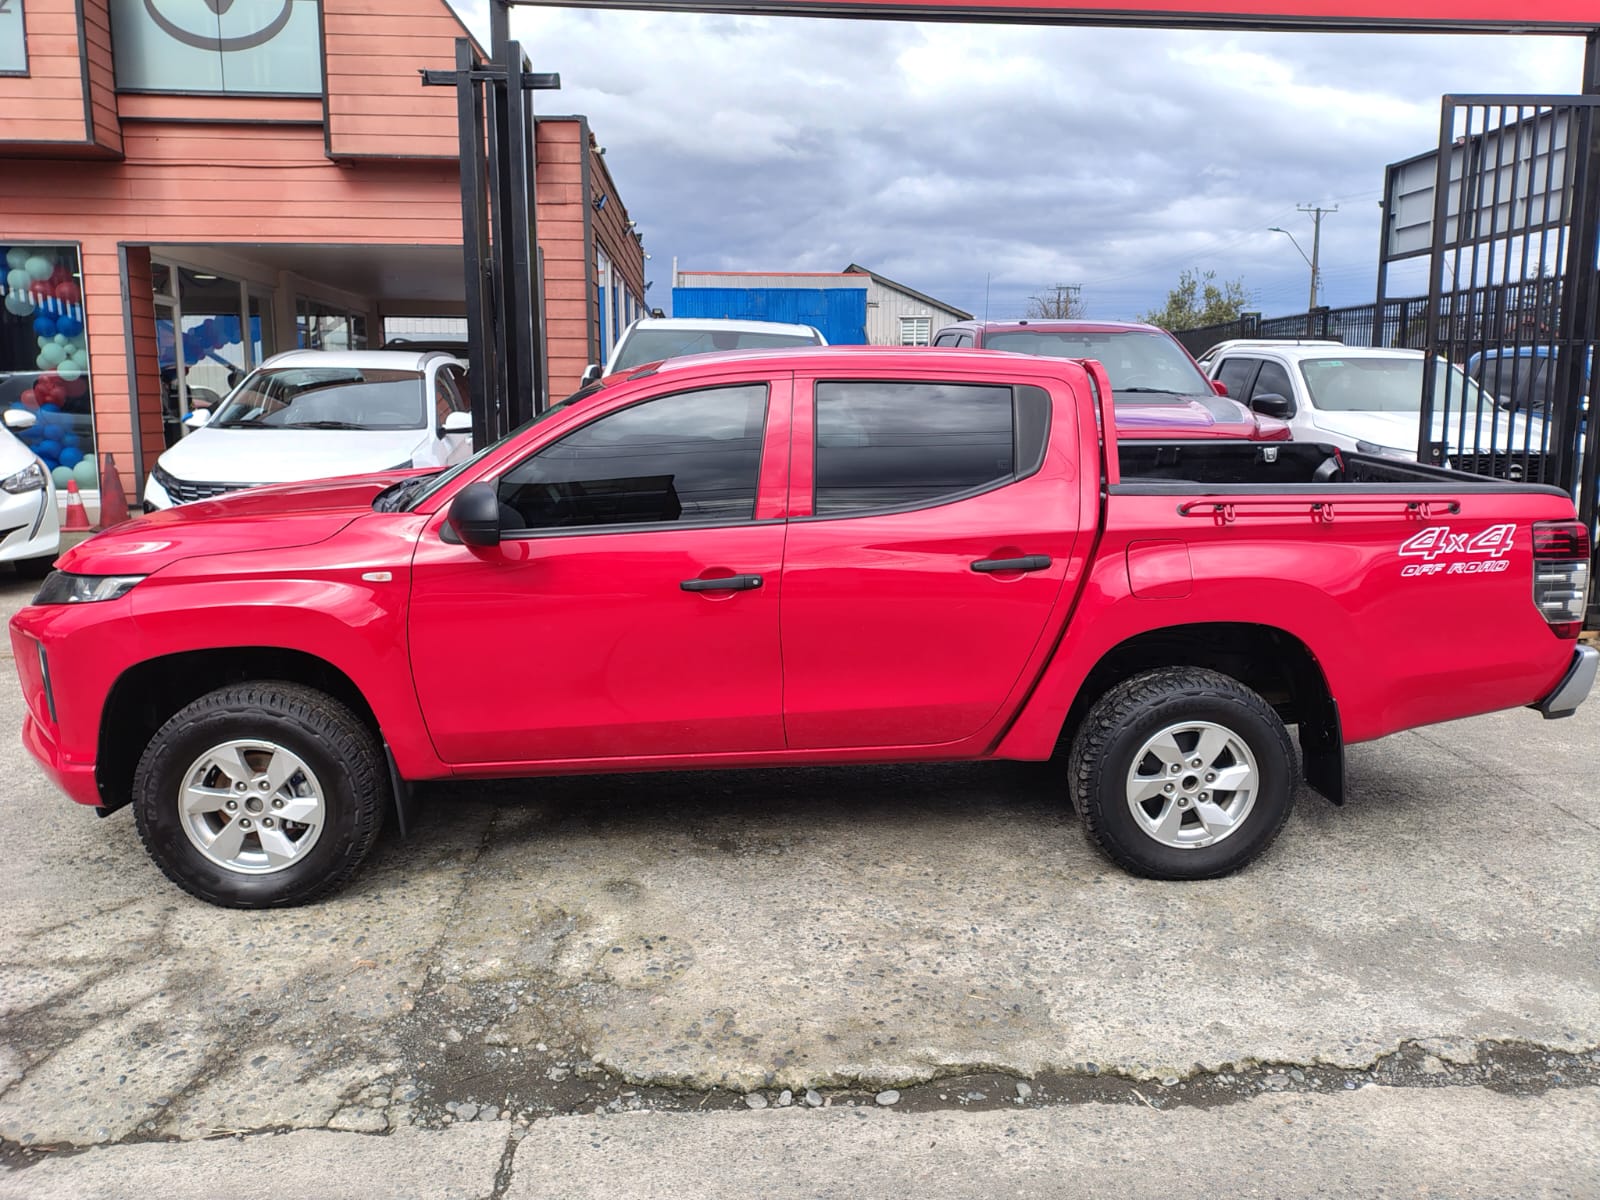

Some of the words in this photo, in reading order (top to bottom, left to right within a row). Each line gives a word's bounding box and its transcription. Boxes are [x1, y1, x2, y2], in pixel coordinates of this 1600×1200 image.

[1398, 524, 1517, 560] 4x4
[1401, 563, 1446, 577] OFF
[1446, 560, 1510, 574] ROAD
